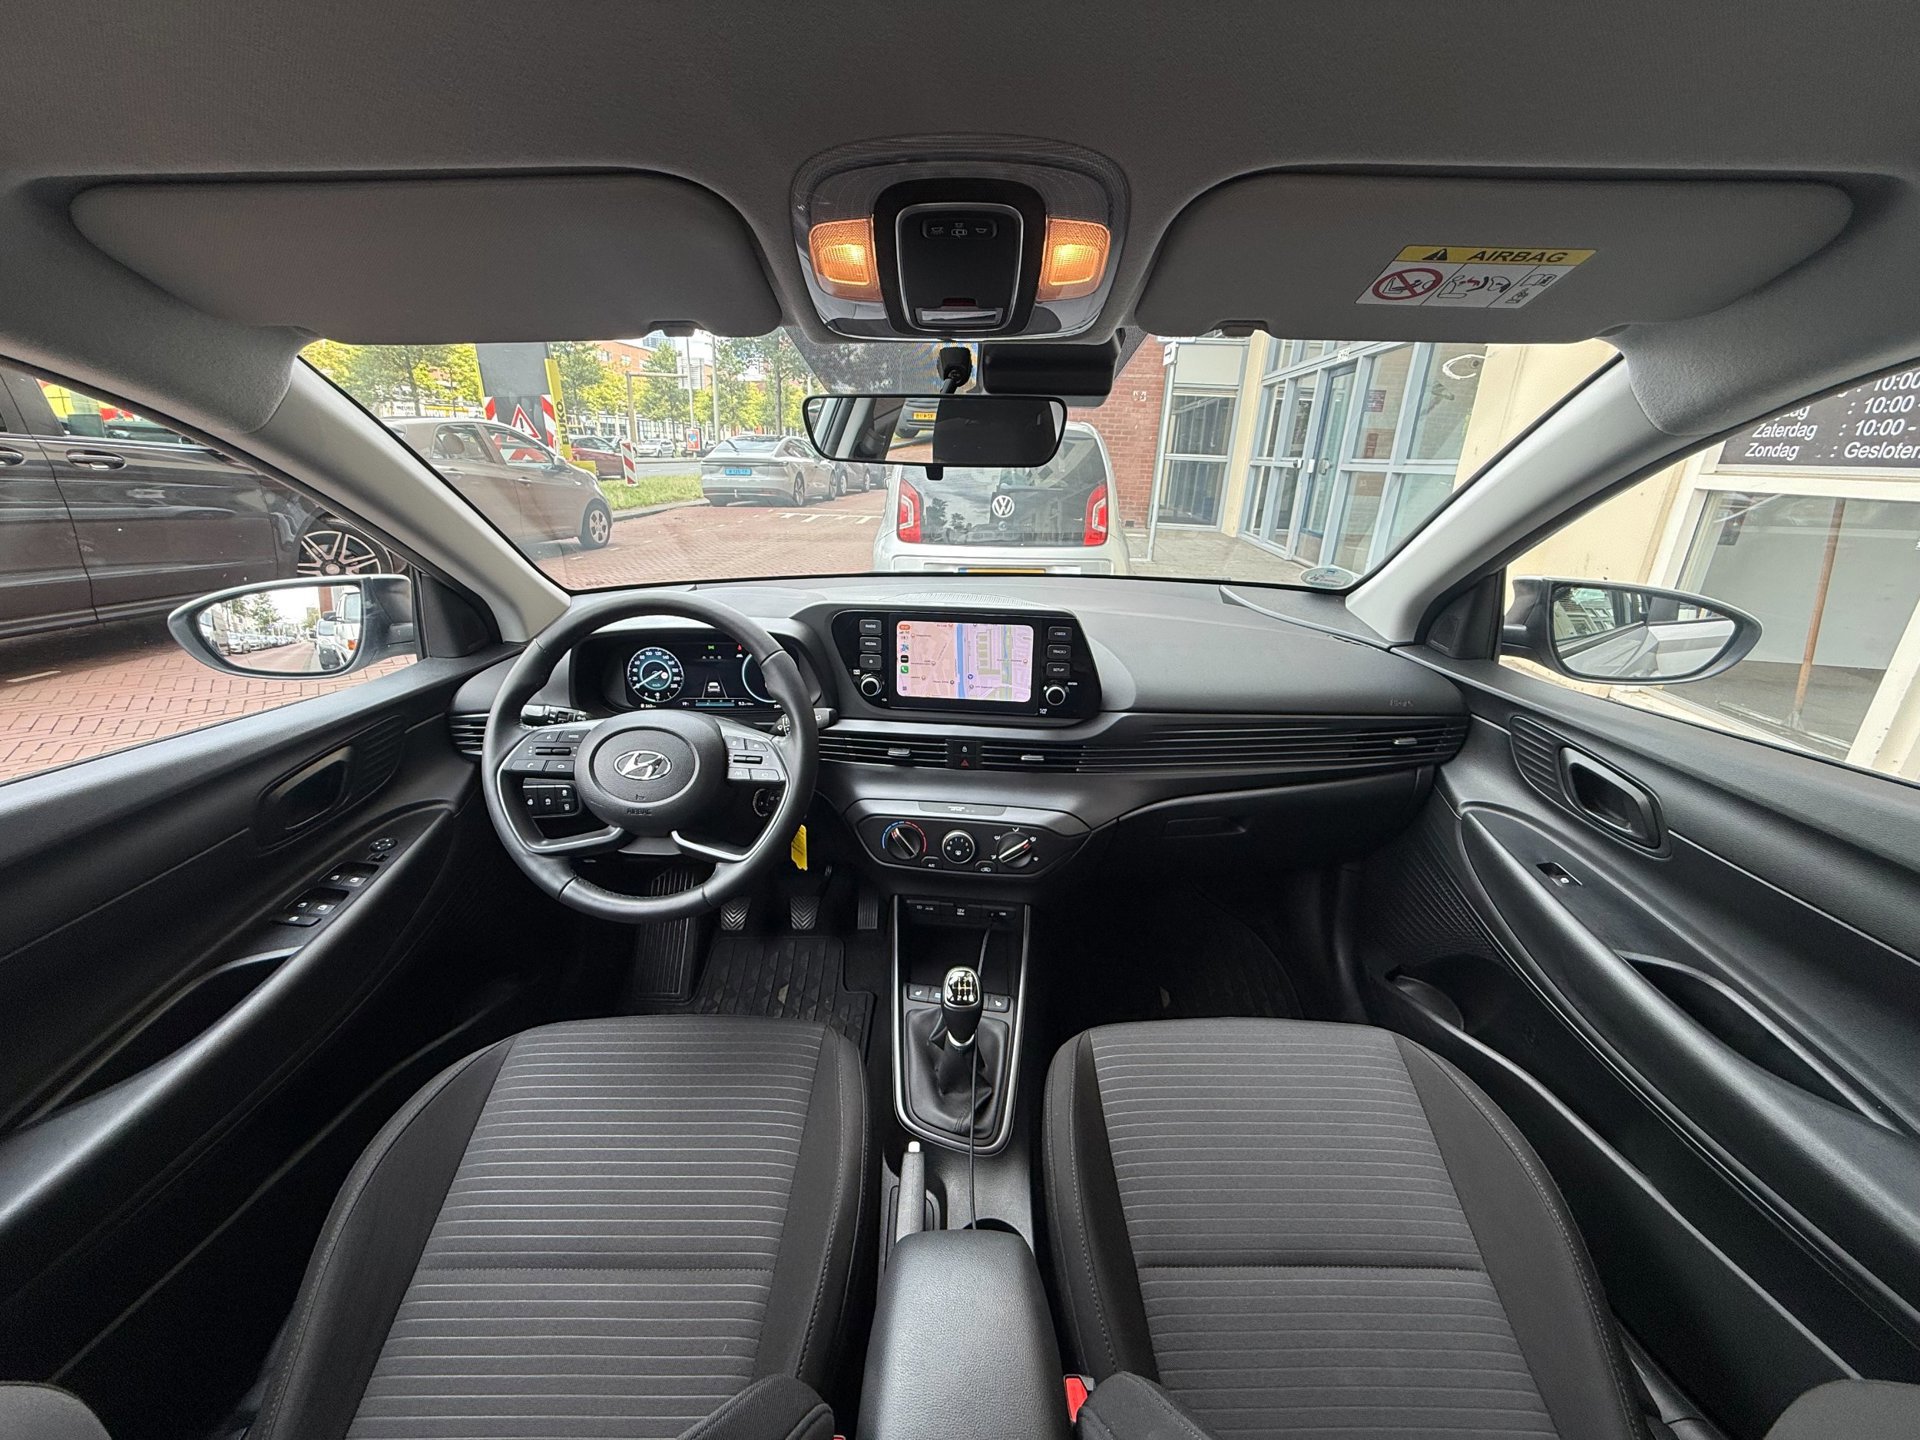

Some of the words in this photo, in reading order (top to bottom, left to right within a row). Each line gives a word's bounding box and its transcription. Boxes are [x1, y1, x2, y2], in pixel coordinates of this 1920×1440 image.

[1467, 250, 1568, 263] AIRBAG
[1864, 395, 1915, 414] 10:00
[556, 400, 569, 445] BUKO
[1751, 421, 1818, 441] Zaterdag
[1855, 418, 1905, 436] 10:00
[1744, 442, 1800, 461] Zondag
